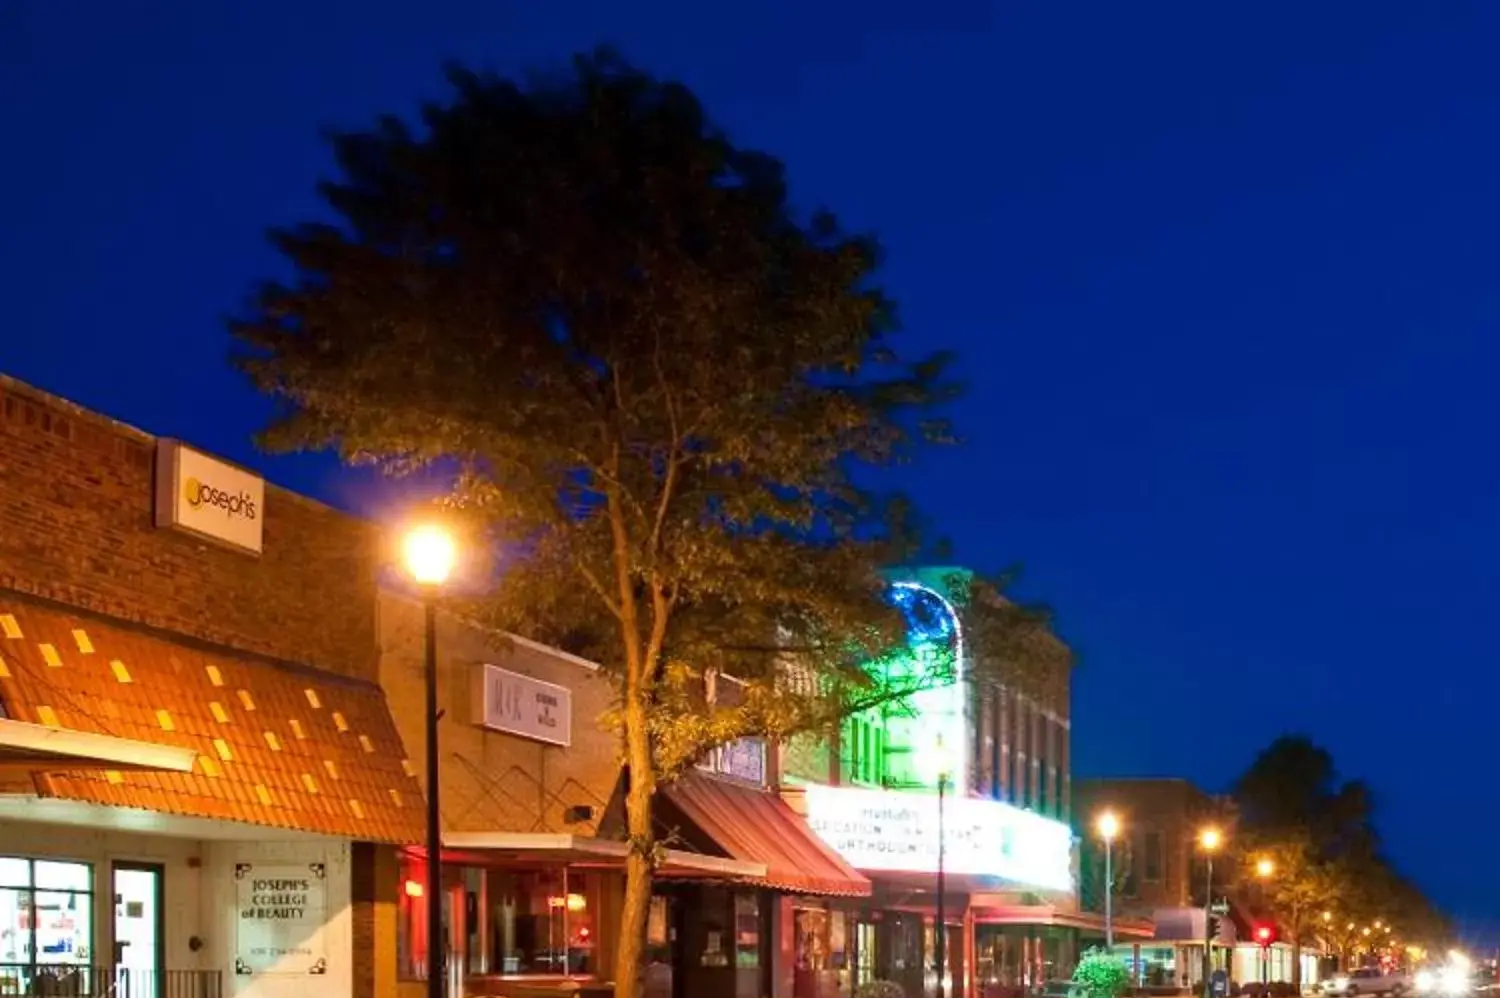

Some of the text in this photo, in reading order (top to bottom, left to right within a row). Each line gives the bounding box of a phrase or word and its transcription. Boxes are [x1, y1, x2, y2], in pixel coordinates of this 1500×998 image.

[253, 879, 309, 892] JOSEPH'S
[252, 893, 307, 905] COLLEGE
[242, 907, 304, 919] of BEAUTY
